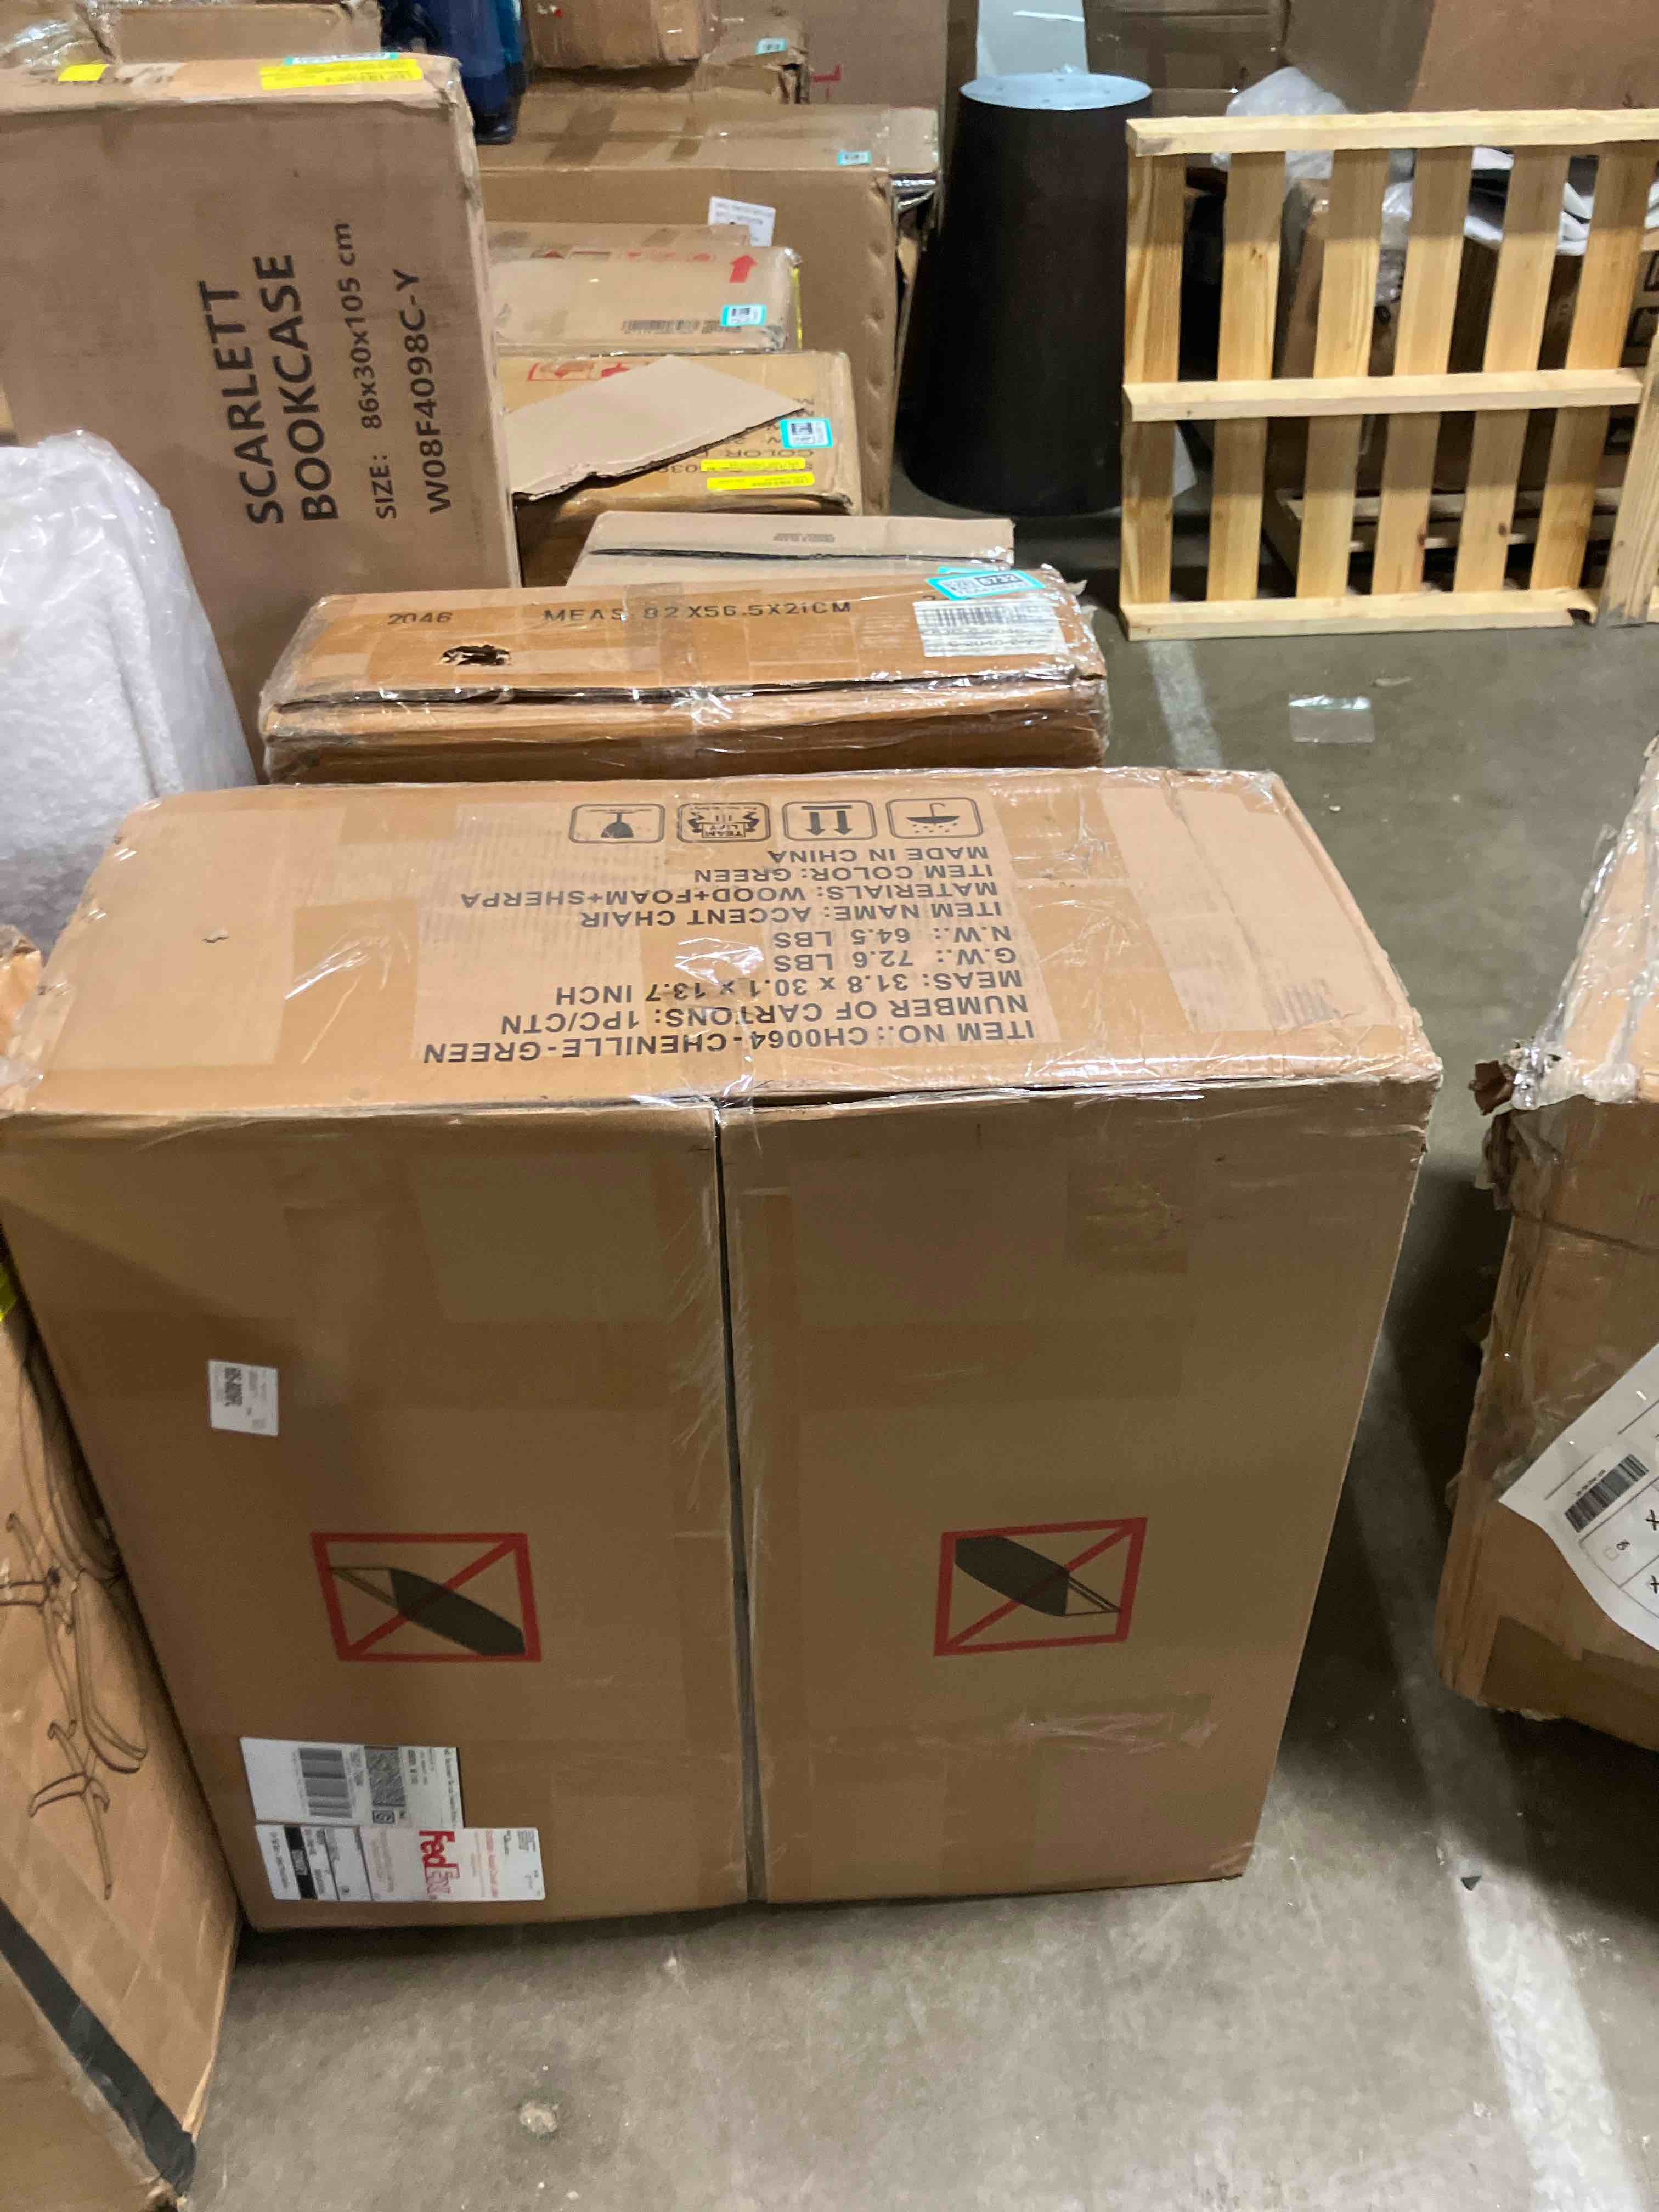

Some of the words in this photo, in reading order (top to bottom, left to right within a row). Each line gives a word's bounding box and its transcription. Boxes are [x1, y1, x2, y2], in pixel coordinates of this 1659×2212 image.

[334, 222, 357, 267] cm
[337, 276, 382, 430] 86x30x105
[253, 255, 339, 522] BOOKCASE
[392, 268, 452, 515] W08F4098C-Y
[198, 280, 285, 524] SCARLETT
[369, 454, 397, 520] SIZE:
[386, 611, 453, 625] 2046
[767, 849, 857, 864] CHINA
[868, 849, 895, 861] IN
[906, 846, 989, 860] MADE
[693, 867, 791, 883] GREEN
[802, 866, 914, 881] COLOR:
[923, 864, 993, 878] ITEM
[460, 885, 806, 910] WOOD+FOAM+SHERPA
[816, 882, 998, 900] MATERIALS:
[579, 909, 676, 928] CHAIR
[686, 906, 811, 926] ACCENT
[825, 903, 919, 921] NAME:
[932, 901, 1001, 918] ITEM
[773, 929, 833, 949] LBS
[850, 927, 911, 946] 64.5
[933, 925, 1012, 944] N.W.:
[773, 953, 833, 973] LBS
[853, 949, 914, 969] 72.6
[936, 947, 1017, 965] G.W.:
[749, 977, 808, 998] 30.1
[819, 977, 836, 990] x
[847, 973, 908, 994] 31.8
[923, 969, 1023, 989] MEAS:
[555, 984, 633, 1006] INCH
[645, 982, 706, 1002] 13.7
[654, 1002, 822, 1028] CARTONS:
[836, 1001, 877, 1020] OF
[888, 995, 1029, 1019] NUMBER
[501, 1010, 639, 1035] 1PC/CTN
[958, 1020, 1035, 1040] ITEM
[879, 1024, 944, 1043] NO.:
[419, 1830, 460, 1894] FedEx
